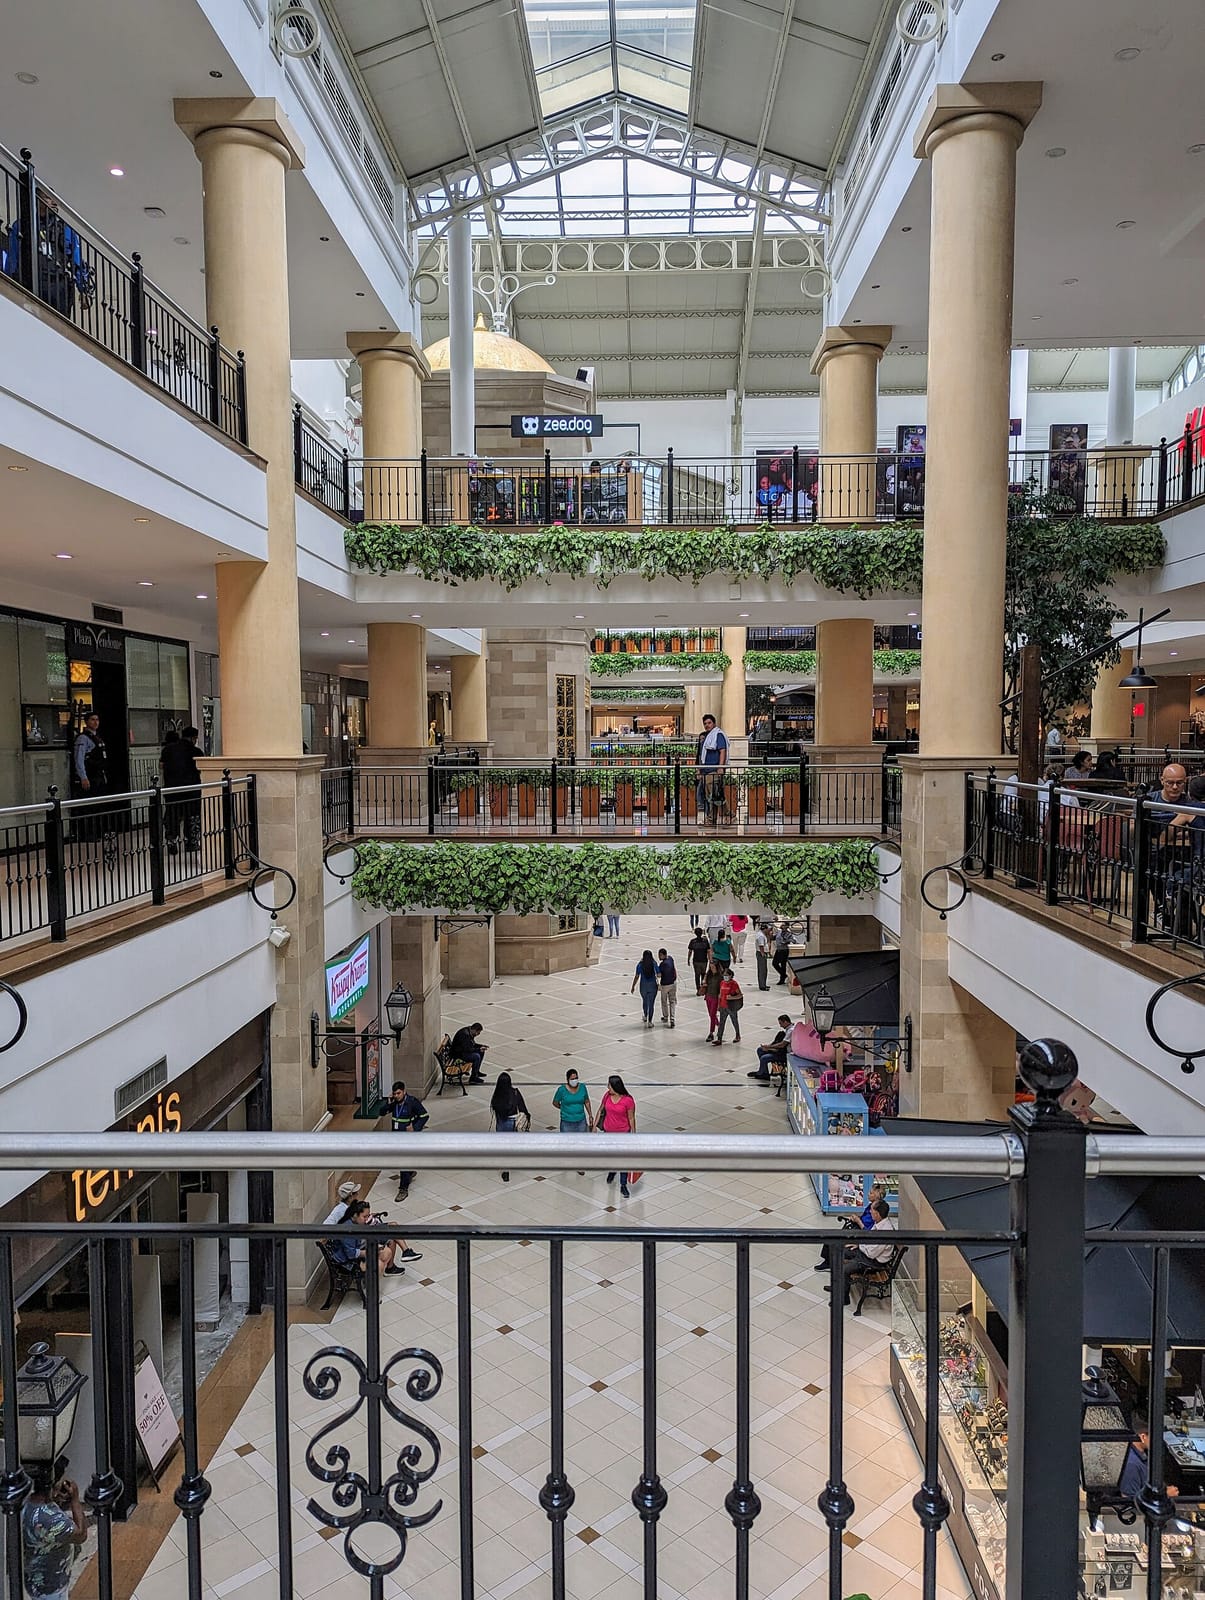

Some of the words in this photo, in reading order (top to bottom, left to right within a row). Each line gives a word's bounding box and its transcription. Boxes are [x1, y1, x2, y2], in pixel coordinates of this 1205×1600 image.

[543, 416, 592, 434] zee.dog
[74, 626, 92, 646] Plaza
[331, 963, 351, 1006] Krispy
[350, 949, 367, 989] Kreme
[139, 1416, 154, 1434] 50%
[152, 1394, 165, 1416] OFF
